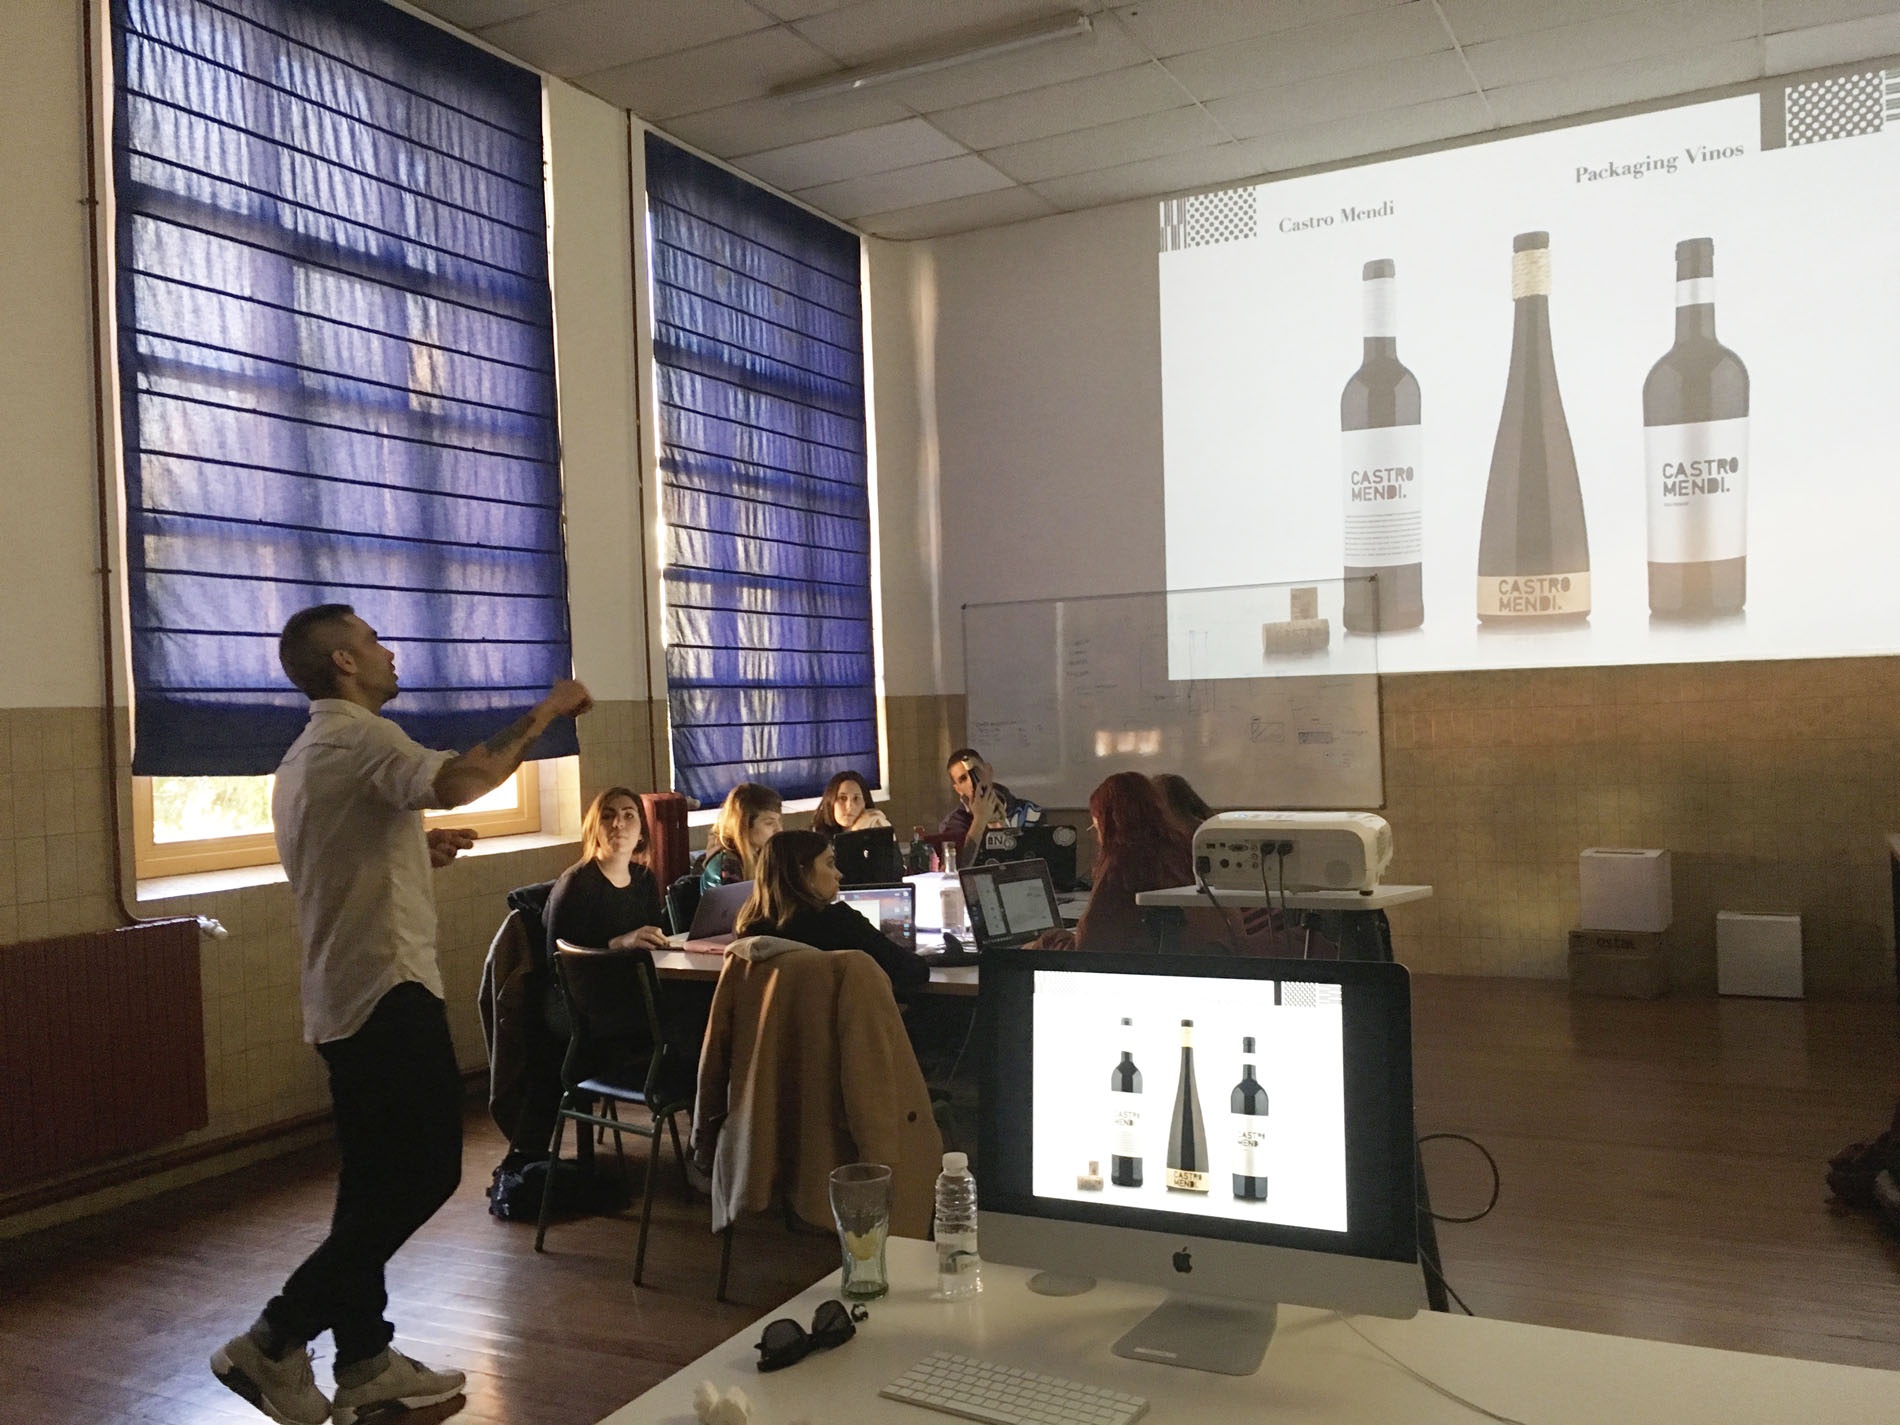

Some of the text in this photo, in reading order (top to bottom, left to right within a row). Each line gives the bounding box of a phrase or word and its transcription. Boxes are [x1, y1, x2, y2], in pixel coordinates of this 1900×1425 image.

[1575, 144, 1745, 184] Packaging Vinos
[1279, 200, 1394, 233] Castro Mendi
[1351, 466, 1414, 486] CASTRO
[1662, 457, 1739, 479] CASTRO
[1351, 483, 1407, 502] MENDI.
[1663, 476, 1731, 497] MENDI.
[1498, 576, 1571, 595] CASTRO
[1499, 595, 1563, 612] MENDI.
